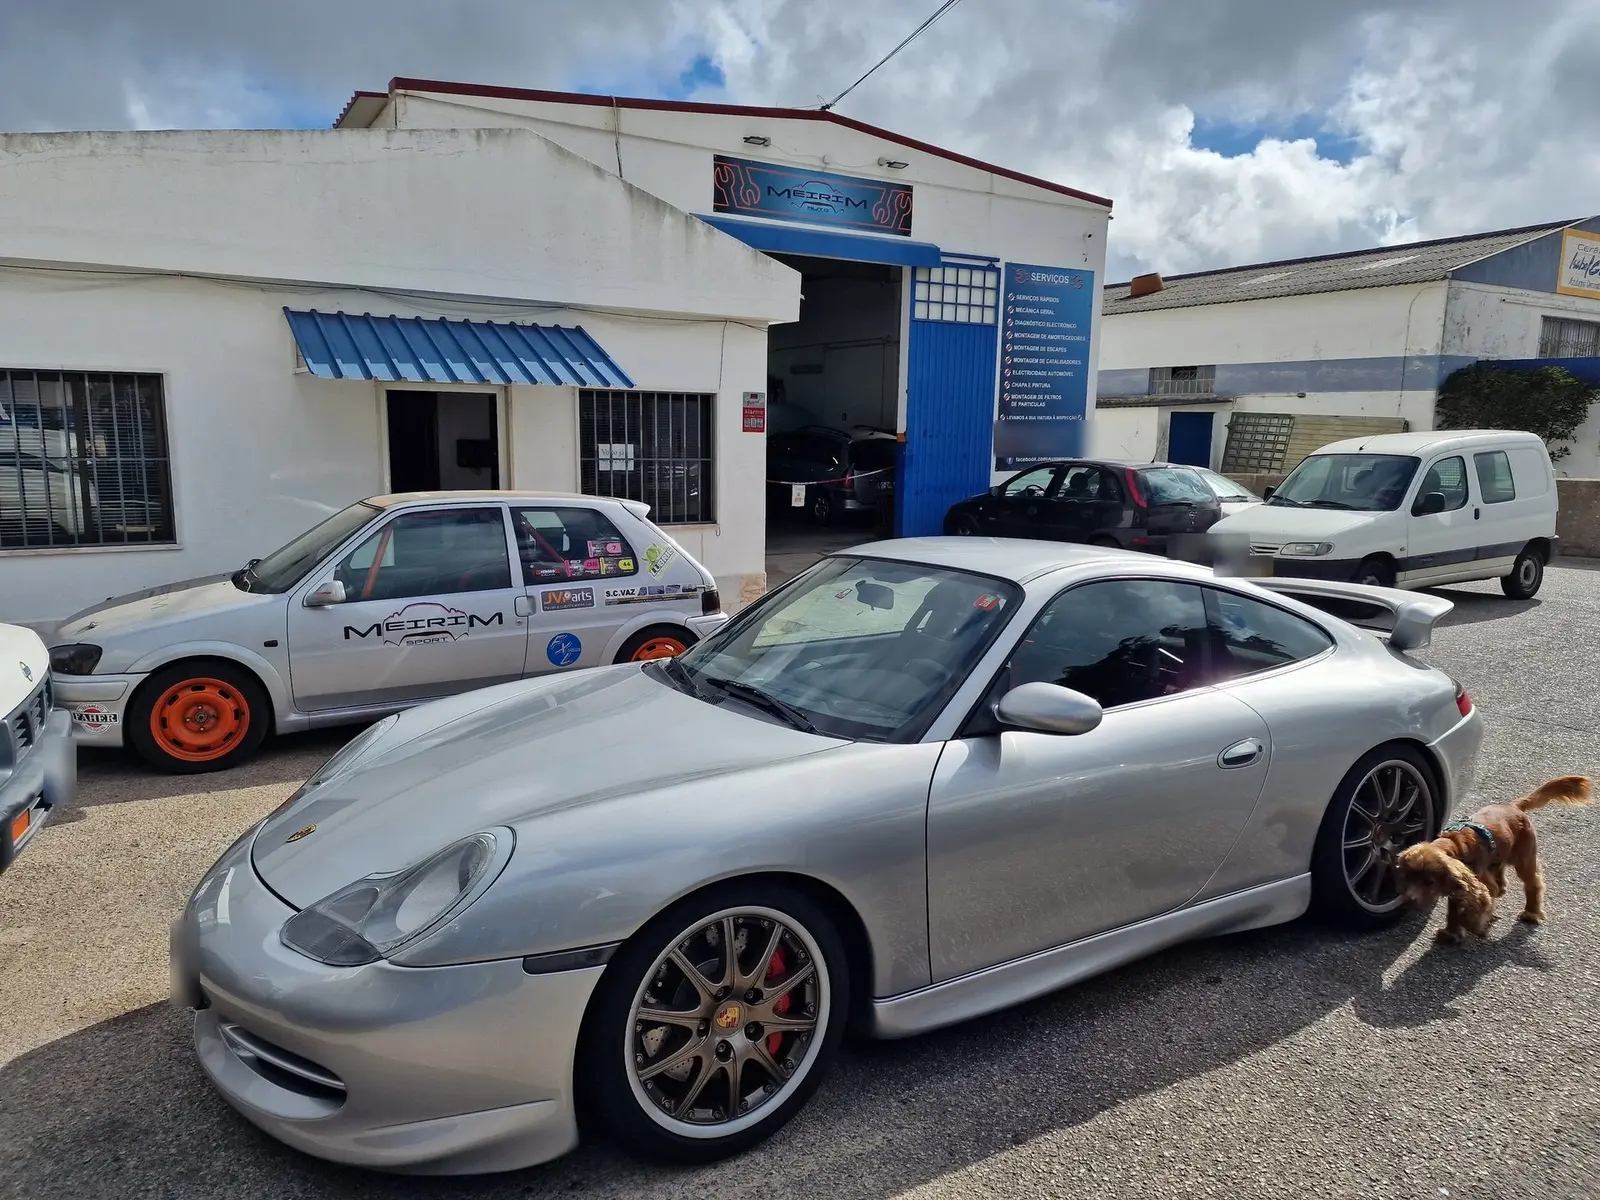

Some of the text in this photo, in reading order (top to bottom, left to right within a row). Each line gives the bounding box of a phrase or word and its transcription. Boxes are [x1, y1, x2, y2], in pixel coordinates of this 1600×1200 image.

[767, 185, 868, 210] MEIRIM
[1577, 243, 1600, 254] Cerâ
[1031, 272, 1070, 284] SERVIÇOS
[1016, 294, 1060, 303] SERVIÇOS RÁPIDOS
[1015, 306, 1040, 314] MECÂNICA
[1014, 319, 1046, 327] DIAGNÓSTICO
[601, 448, 618, 456] Voo
[605, 588, 636, 598] S.C.VAZ
[344, 611, 504, 640] MEIRIM
[406, 636, 449, 646] SPORT
[75, 713, 116, 722] FAHER
